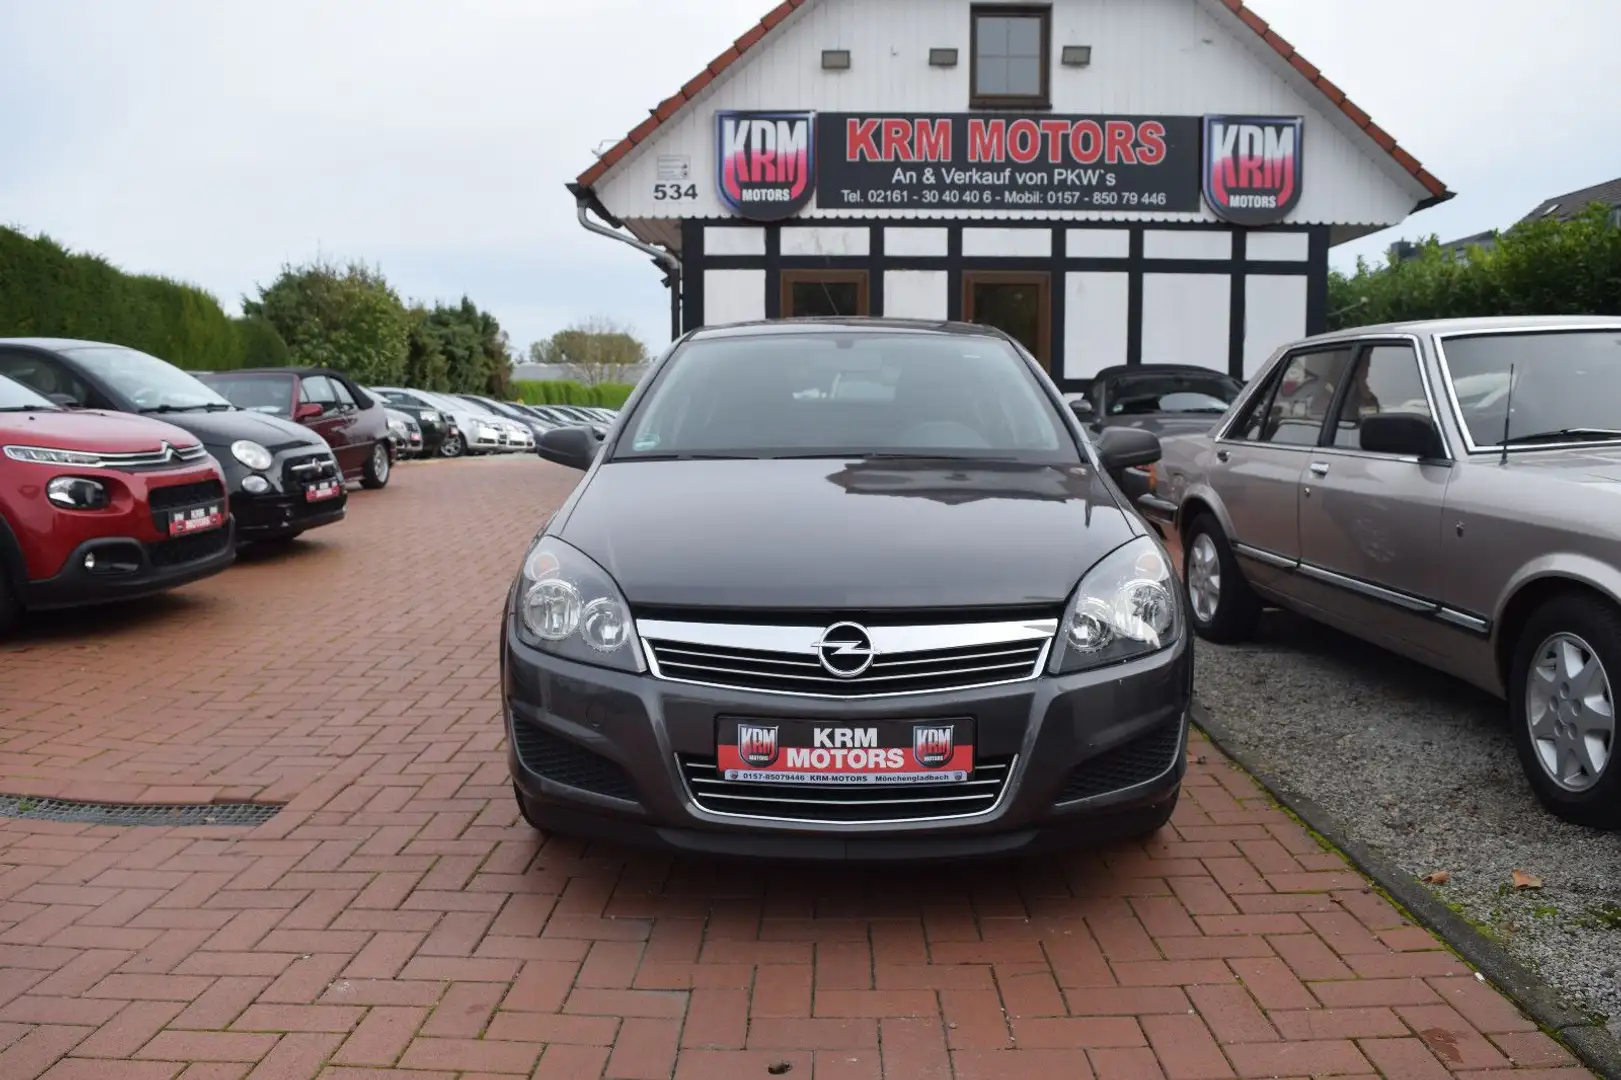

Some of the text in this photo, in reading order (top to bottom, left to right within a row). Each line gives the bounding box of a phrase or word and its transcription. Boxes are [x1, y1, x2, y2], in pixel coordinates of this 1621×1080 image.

[846, 117, 1167, 165] KRM MOTORS
[724, 119, 807, 200] KRM
[1212, 124, 1294, 207] KRM
[891, 167, 917, 184] An
[922, 167, 936, 184] &
[941, 167, 1012, 185] Verkauf
[1015, 171, 1048, 186] von
[653, 183, 698, 201] 534
[741, 188, 790, 202] MOTORS
[841, 189, 864, 203] Tel.
[867, 189, 908, 203] 02161
[922, 189, 939, 203] 30
[941, 189, 960, 203] 40
[962, 189, 980, 203] 40
[1004, 190, 1043, 204] Mobil:
[1047, 191, 1080, 204] 0157
[1092, 191, 1118, 205] 850
[1121, 191, 1138, 205] 79
[1141, 192, 1167, 205] 446
[1229, 195, 1277, 208] MOTORS
[741, 727, 776, 760] KRM
[813, 727, 878, 748] KRM
[786, 747, 904, 769] MOTORS
[809, 774, 868, 783] KRM-MOTORS
[875, 774, 949, 783] Mönchengladbach
